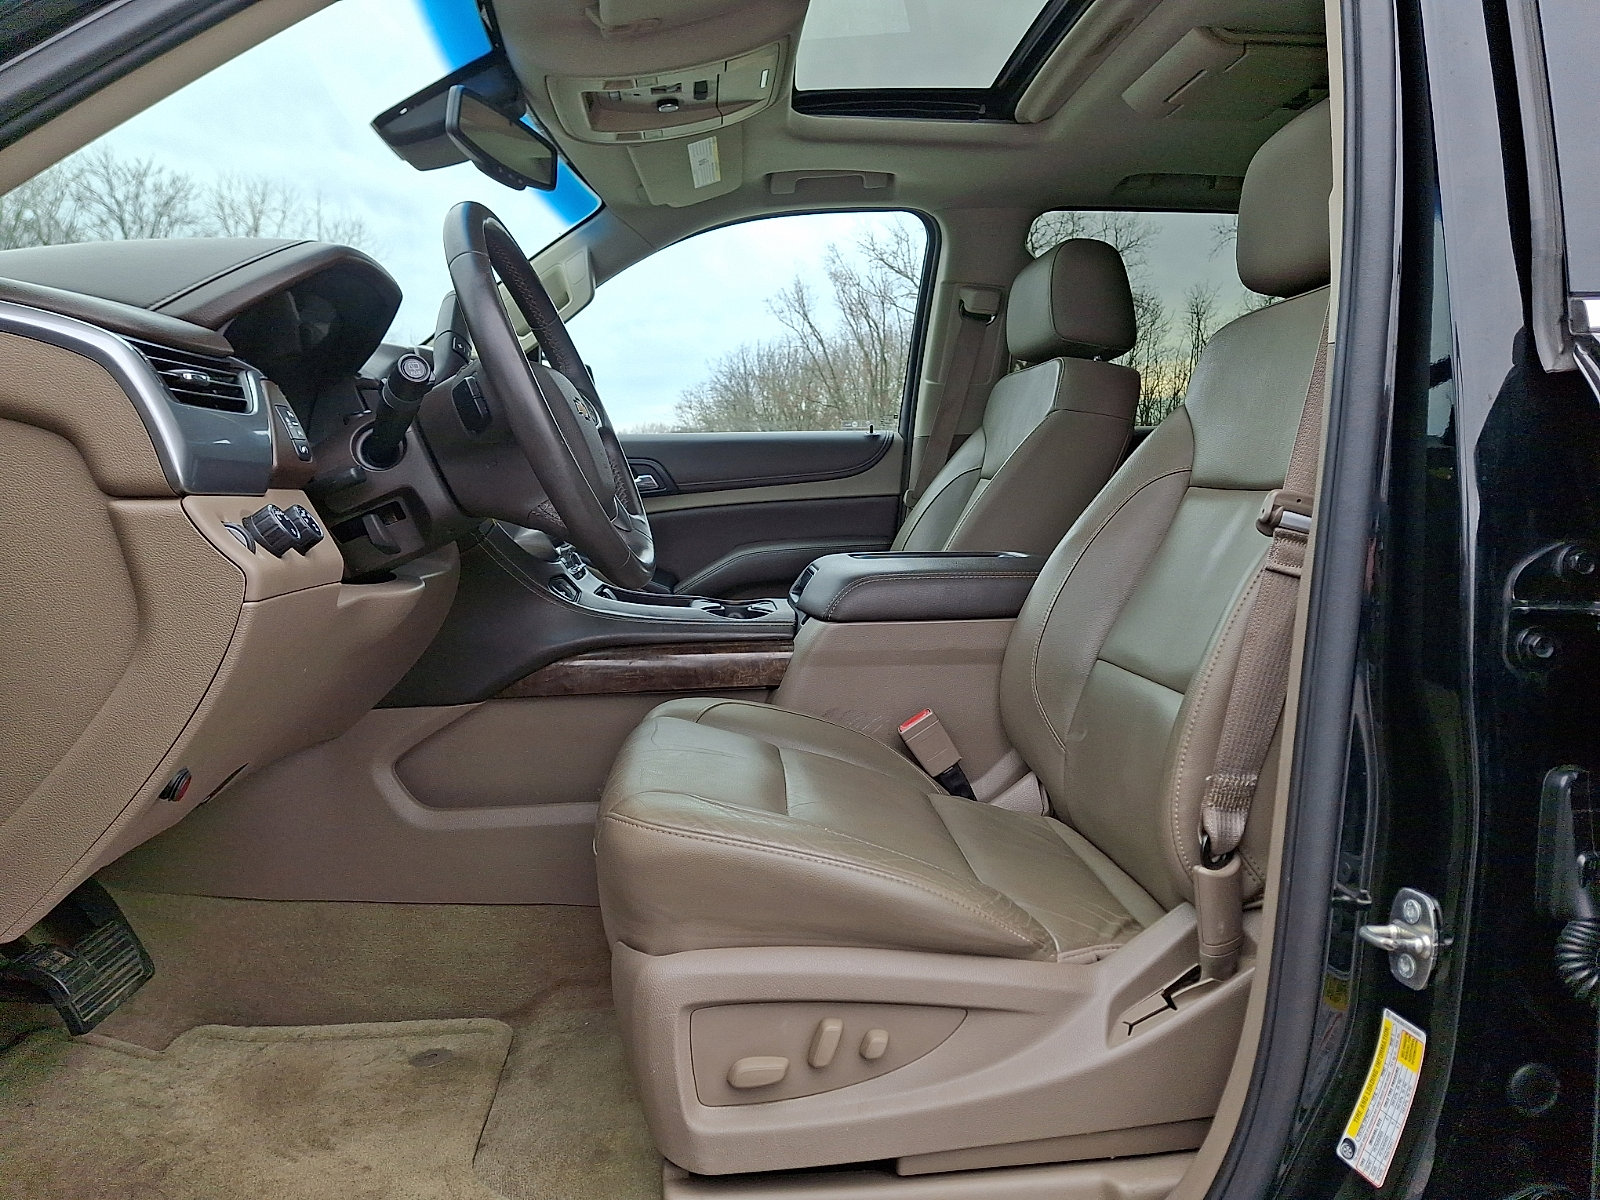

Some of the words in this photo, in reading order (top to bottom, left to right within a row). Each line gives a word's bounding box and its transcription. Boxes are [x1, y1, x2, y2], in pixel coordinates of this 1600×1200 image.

[1354, 1111, 1363, 1123] TIRE
[1360, 1096, 1369, 1110] AND
[1365, 1069, 1379, 1095] LOADING
[1376, 1026, 1390, 1068] INFORMATION
